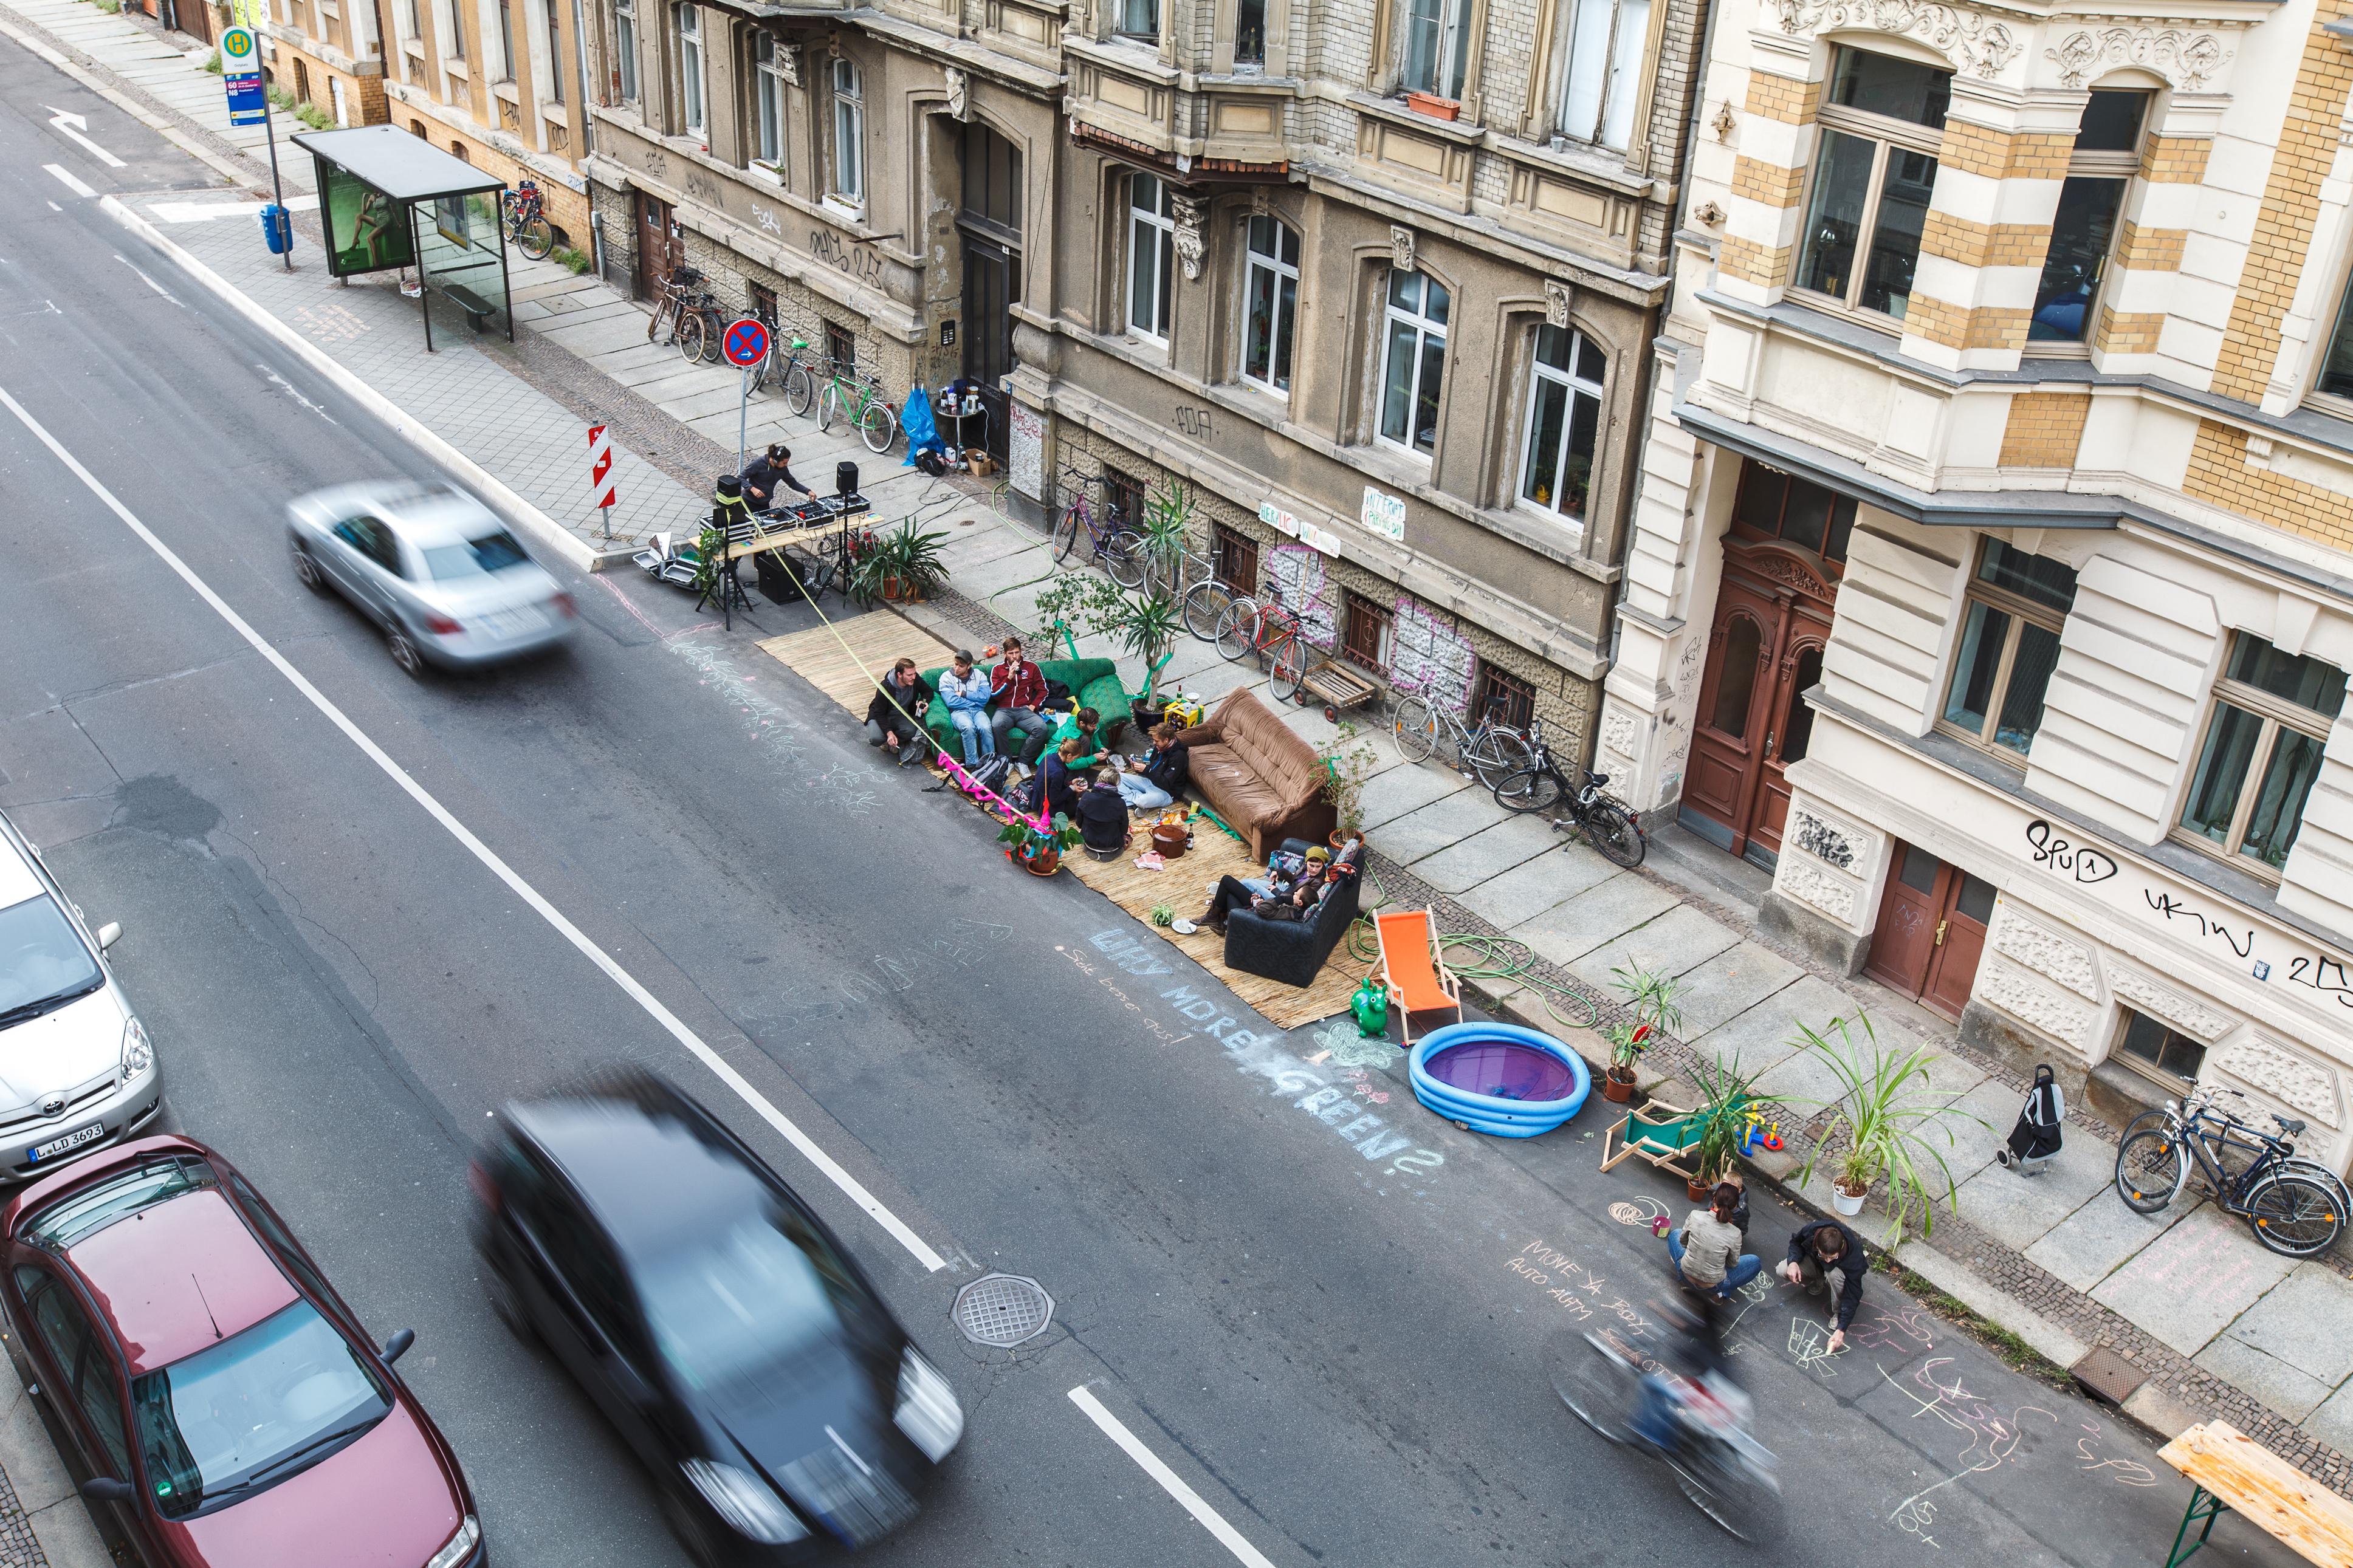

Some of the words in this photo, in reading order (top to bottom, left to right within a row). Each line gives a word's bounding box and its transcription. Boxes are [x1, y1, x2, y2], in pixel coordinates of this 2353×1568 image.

[232, 35, 244, 52] H
[1097, 977, 1141, 1013] besser
[52, 1138, 69, 1152] LD
[72, 1125, 102, 1145] 3693
[1503, 1258, 1548, 1284] AUTO
[1522, 1240, 1583, 1278] MOVE
[1578, 1270, 1606, 1296] YA
